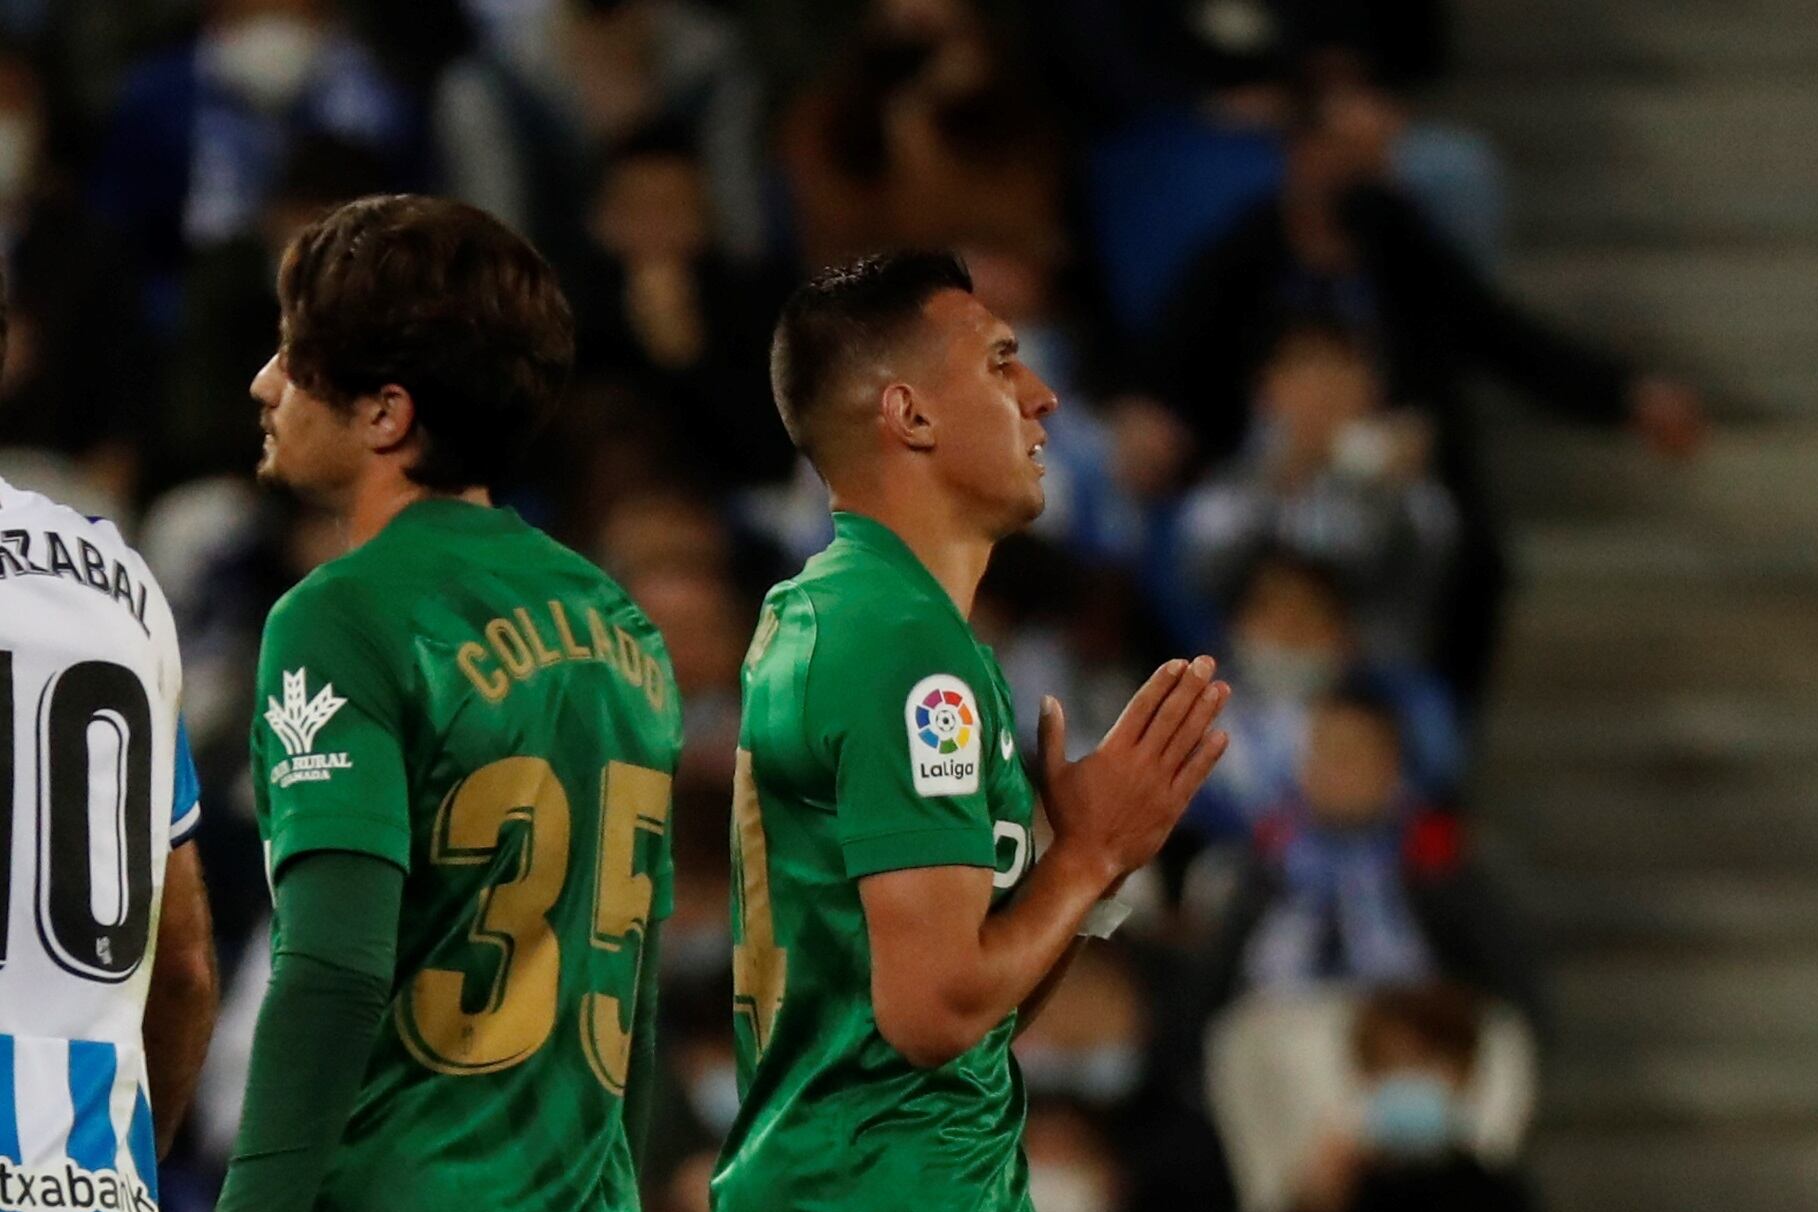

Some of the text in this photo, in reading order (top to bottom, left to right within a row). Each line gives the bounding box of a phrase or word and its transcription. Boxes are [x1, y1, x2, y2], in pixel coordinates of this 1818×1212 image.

[456, 600, 665, 712] COLLADO
[292, 752, 353, 771] RURAL
[394, 755, 672, 1097] 35
